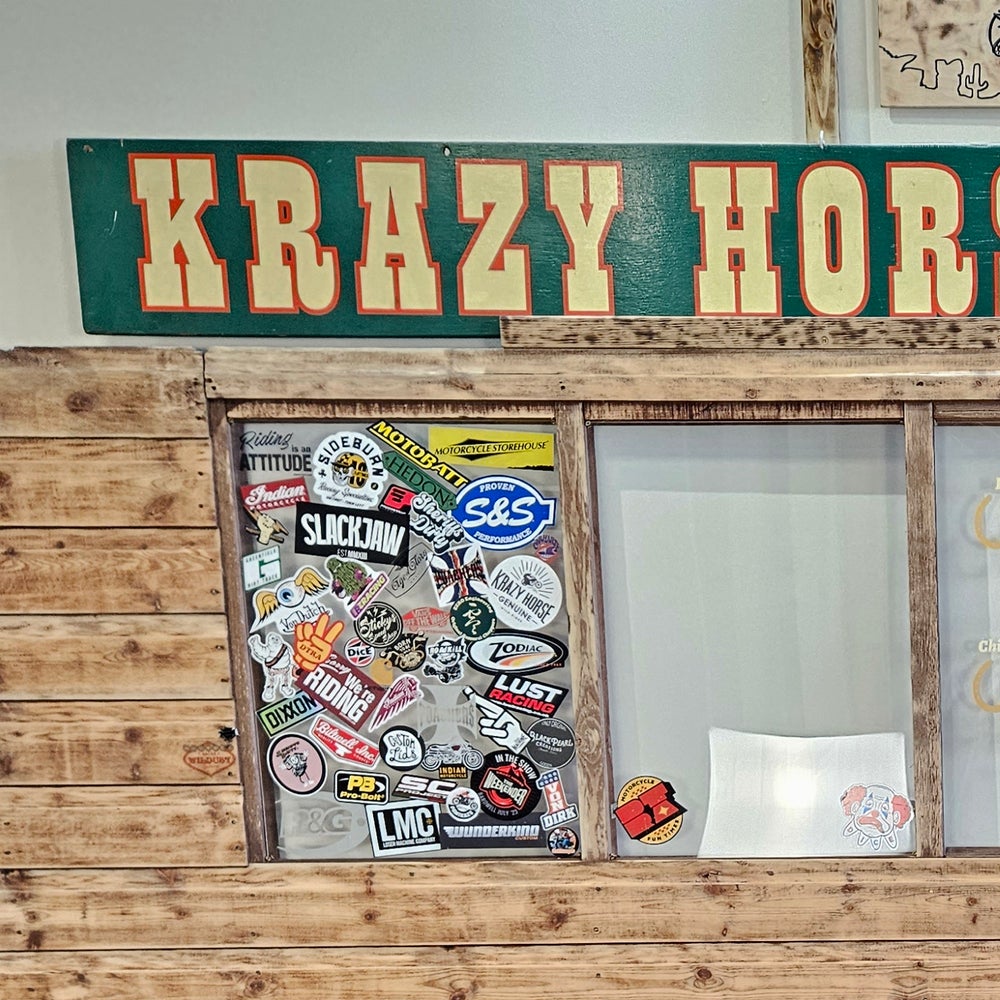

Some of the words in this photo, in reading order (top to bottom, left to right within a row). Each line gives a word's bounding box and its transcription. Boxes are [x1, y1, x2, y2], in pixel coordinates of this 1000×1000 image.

[128, 153, 623, 316] KRAZY
[240, 430, 294, 450] Riding
[435, 443, 491, 455] MOTORCYCLE
[492, 440, 550, 452] STOREHOUSE
[239, 453, 312, 472] ATTITUDE
[317, 435, 385, 479] SIDEBURN
[372, 420, 469, 488] MOTOBATT
[245, 484, 305, 506] Indian
[388, 456, 451, 508] HEDON
[479, 482, 516, 494] PROVEN
[463, 496, 535, 528] S&S
[300, 513, 406, 556] SLACKJAW
[416, 514, 449, 549] Dirty
[474, 528, 533, 544] PERFORMANCE
[491, 569, 525, 600] KRAZY
[524, 592, 556, 625] HORSE
[498, 595, 533, 623] GENUINE
[280, 614, 299, 633] Von
[299, 643, 322, 661] DTRA
[489, 642, 544, 663] ZODIAC
[302, 667, 370, 724] RIDING
[344, 673, 376, 704] We're
[489, 688, 556, 714] RACING
[494, 674, 562, 703] LUST
[265, 694, 318, 729] DIXXON
[315, 721, 357, 749] Biltwell
[495, 753, 504, 763] IN
[504, 753, 518, 765] THE
[518, 758, 538, 780] SHOW
[347, 775, 376, 792] PB
[401, 776, 457, 795] SC
[485, 770, 528, 807] WEEKENDER
[621, 779, 656, 802] MOTORCYCLE
[377, 806, 434, 842] LMC
[543, 806, 577, 829] DIRK
[444, 824, 540, 839] WUNDERKIND
[647, 834, 663, 843] FUN
[662, 820, 680, 841] TIMES
